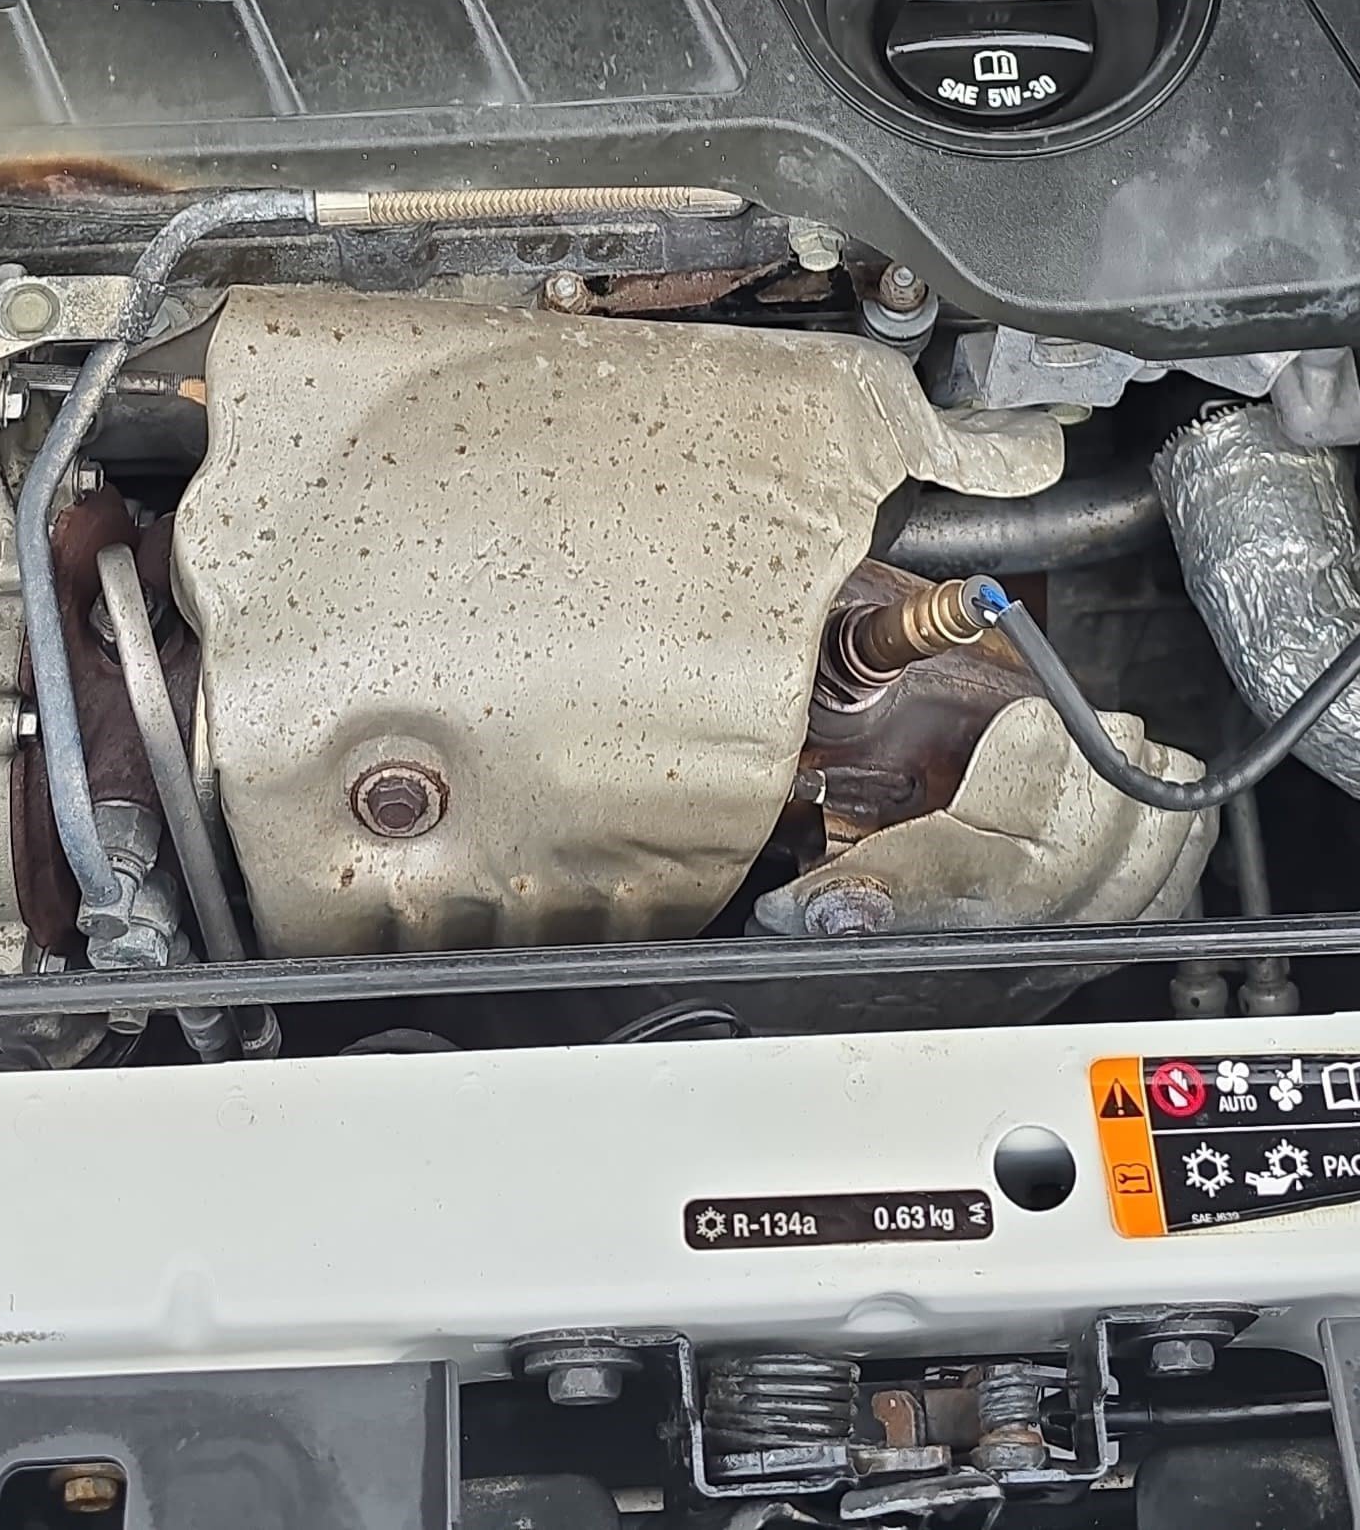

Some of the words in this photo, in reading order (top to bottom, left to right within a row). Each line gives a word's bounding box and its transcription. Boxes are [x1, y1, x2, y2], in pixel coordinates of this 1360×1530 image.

[937, 78, 980, 106] SAE
[987, 74, 1058, 108] 5W-30
[1218, 1094, 1258, 1113] AUTO
[733, 1212, 818, 1238] R-134a
[873, 1205, 925, 1231] 0.63
[929, 1203, 955, 1231] kg
